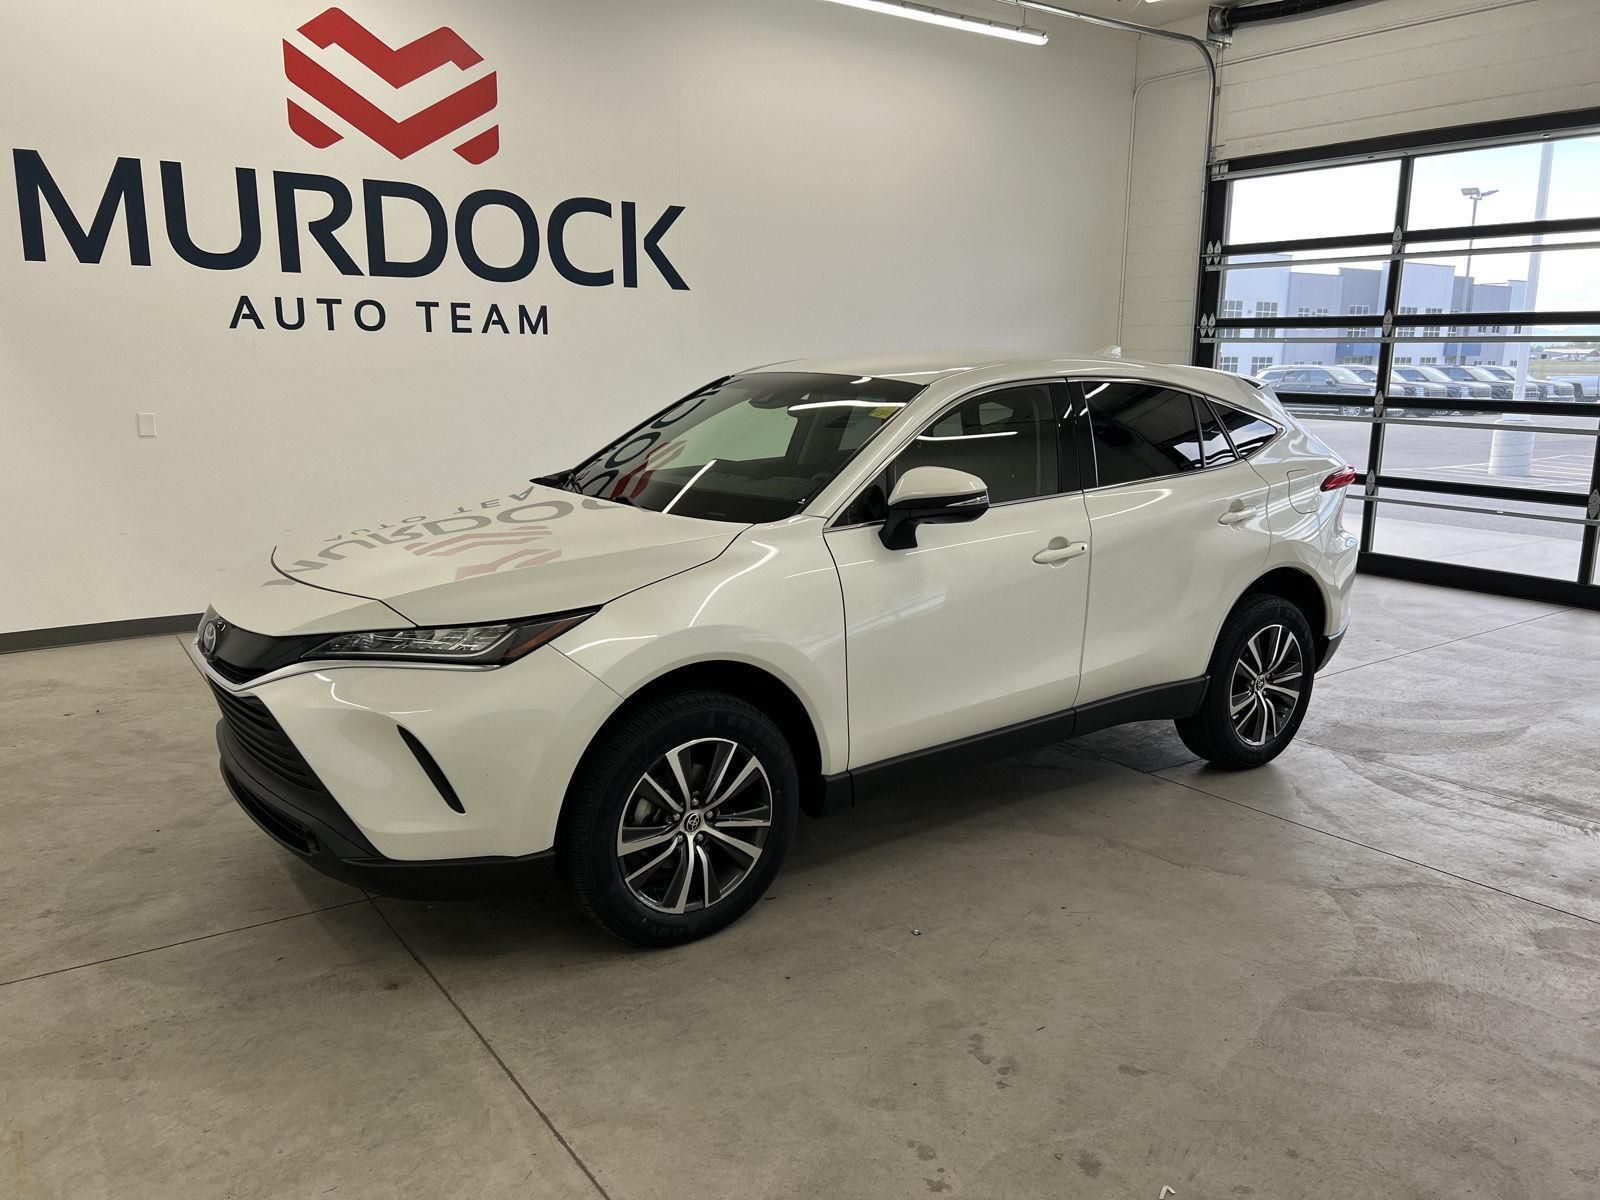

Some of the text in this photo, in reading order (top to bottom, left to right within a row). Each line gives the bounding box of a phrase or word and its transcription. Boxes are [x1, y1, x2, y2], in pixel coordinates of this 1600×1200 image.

[13, 149, 691, 291] MURDOCK
[230, 295, 549, 336] AUTO TEAM
